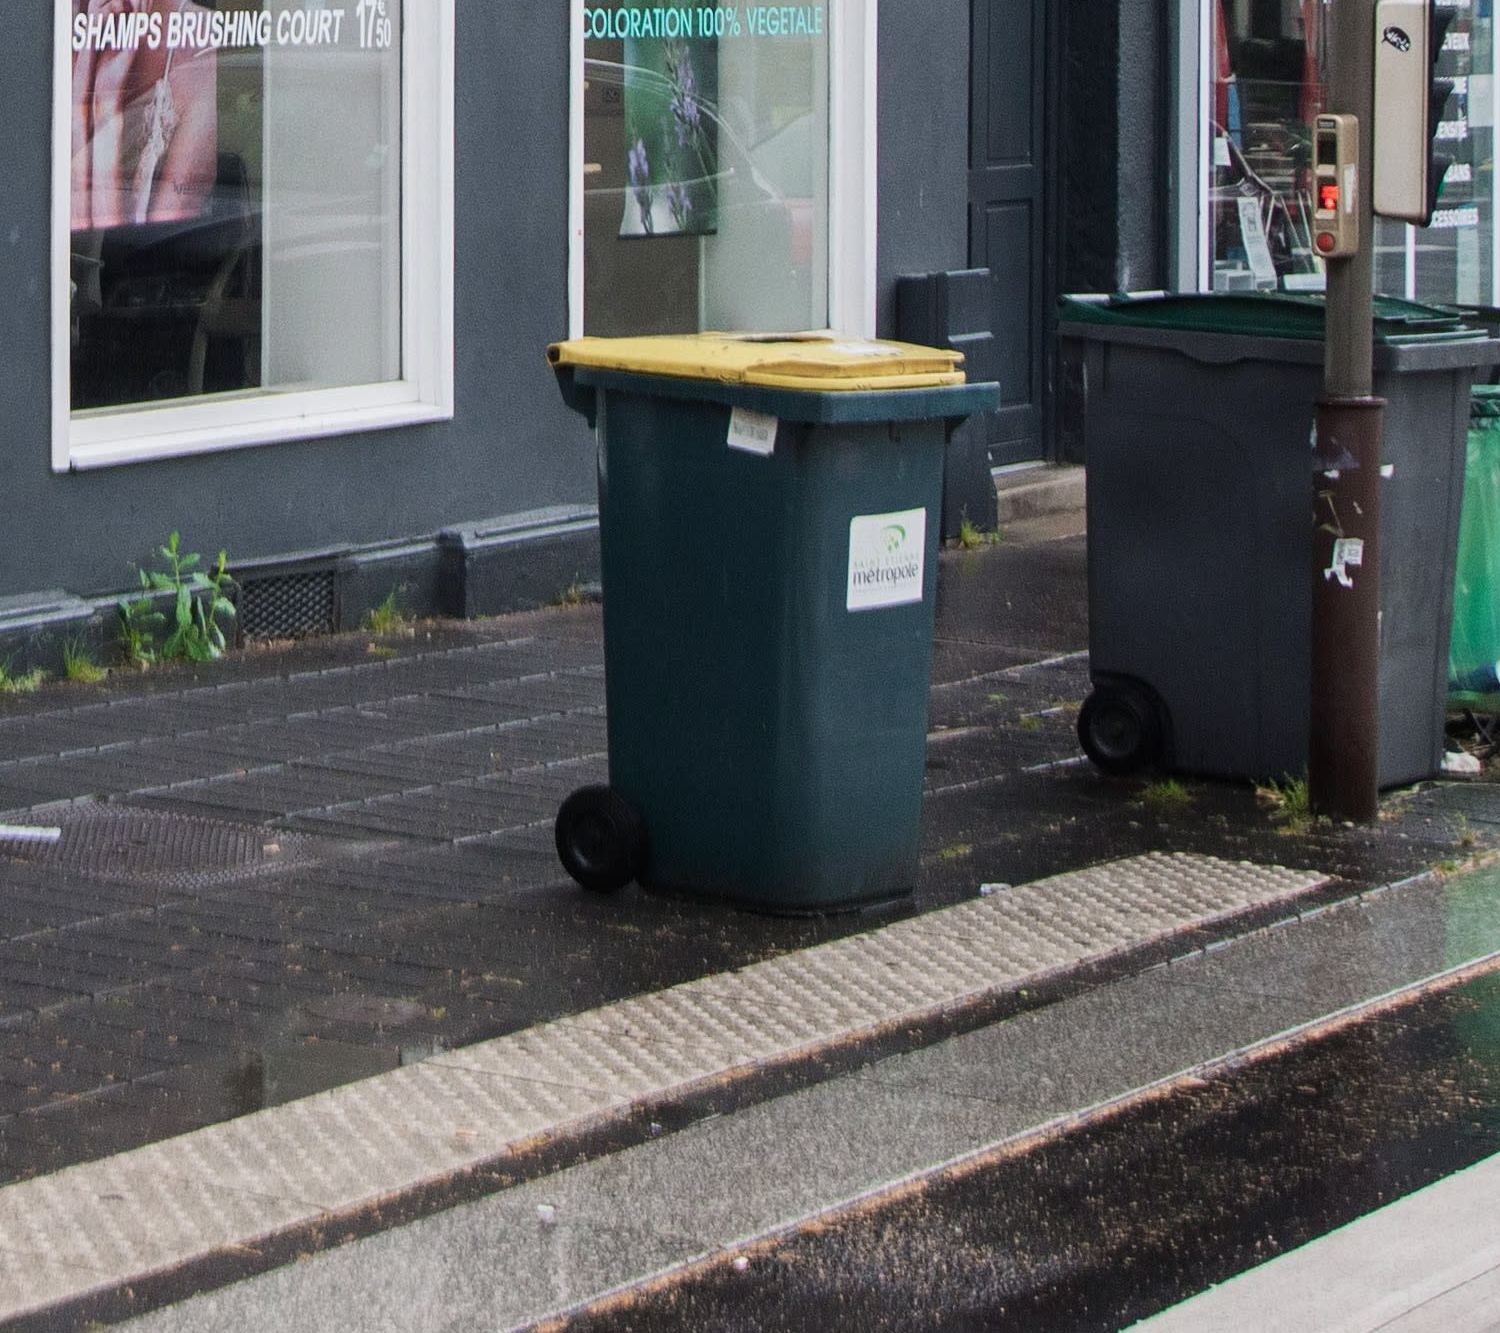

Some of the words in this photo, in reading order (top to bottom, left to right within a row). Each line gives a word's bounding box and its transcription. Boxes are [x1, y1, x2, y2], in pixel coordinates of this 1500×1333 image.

[72, 11, 164, 52] SHAMPS
[165, 9, 273, 50] BRUSHING
[276, 8, 346, 47] COURT
[583, 7, 693, 40] COLORATION
[696, 7, 741, 39] 100%
[745, 6, 823, 36] VEGETALE
